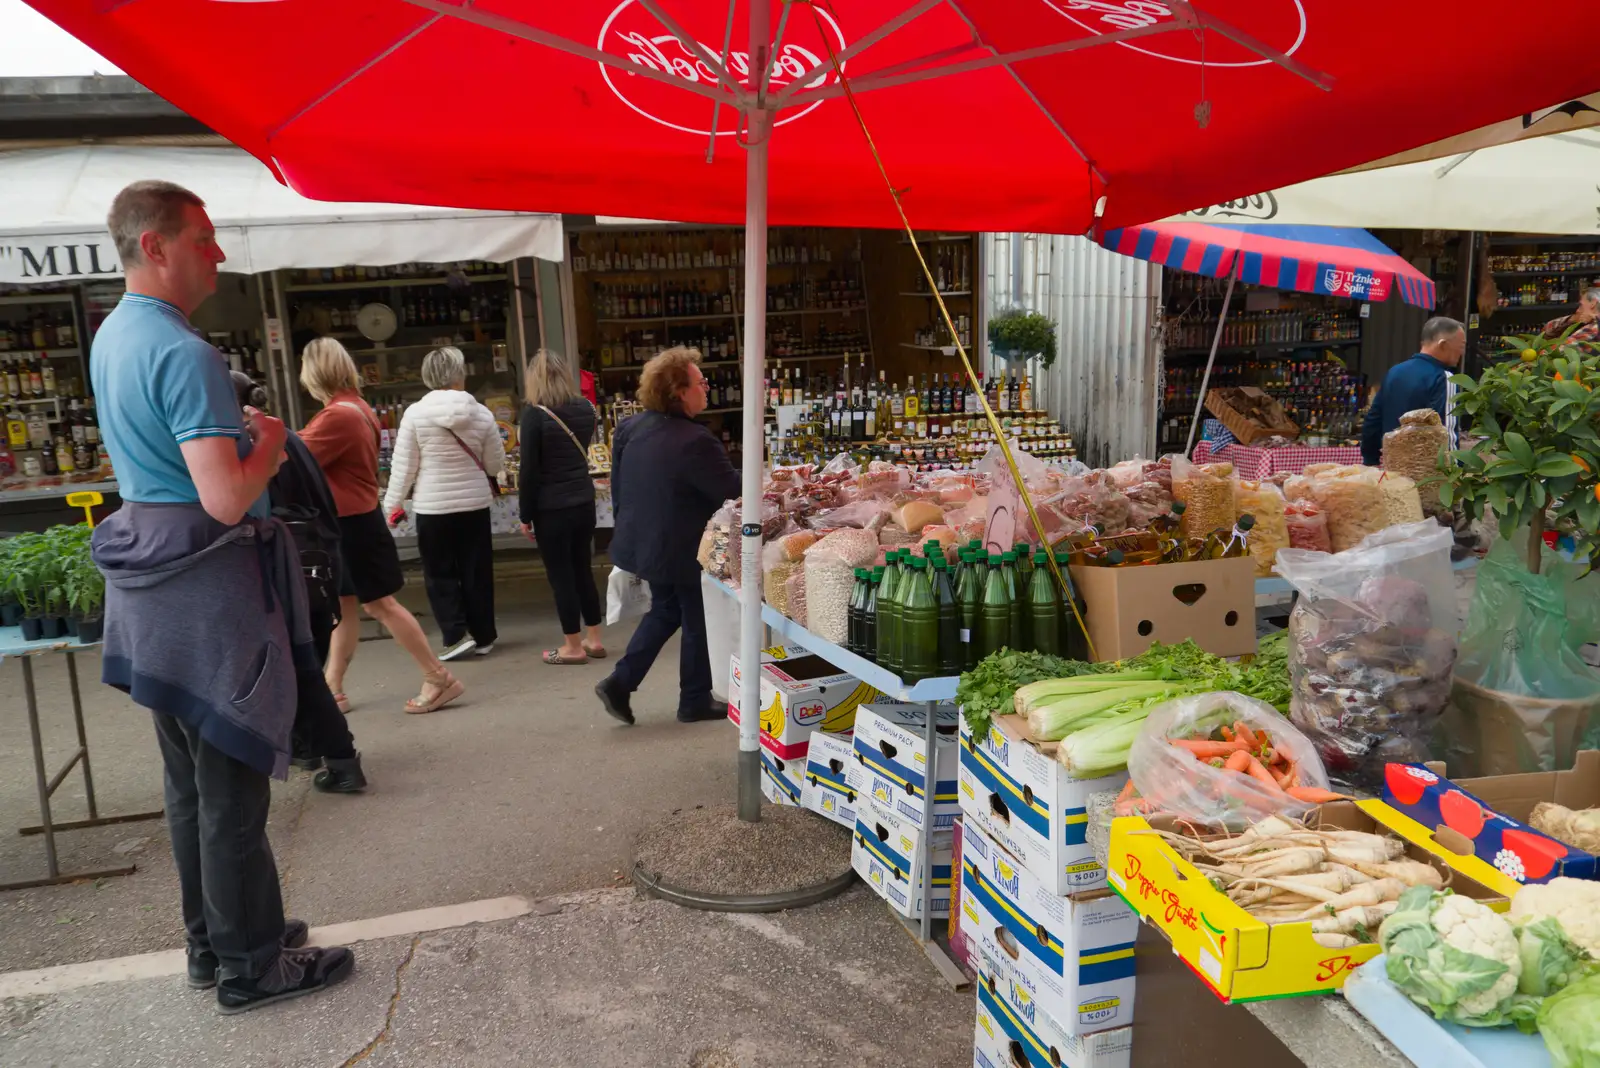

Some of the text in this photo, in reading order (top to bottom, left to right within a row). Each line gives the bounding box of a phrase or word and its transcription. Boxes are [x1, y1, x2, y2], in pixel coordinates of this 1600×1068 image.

[1345, 271, 1381, 286] Tržnice
[1343, 281, 1365, 294] Split
[799, 704, 823, 718] Dole
[874, 720, 914, 748] PREMIUM PACK
[823, 741, 853, 757] PREMIUM PAC
[873, 776, 893, 803] BONITA
[888, 817, 901, 832] PACK
[993, 826, 1027, 860] PREMIUM
[1072, 863, 1101, 871] CUADOR
[992, 856, 1019, 900] BONITA
[1075, 872, 1099, 881] 100%
[1125, 853, 1160, 900] Doppio
[1161, 888, 1198, 931] Gusto
[982, 932, 1037, 994] PREMIUM PACK
[1009, 978, 1035, 1026] BONITA
[1087, 1009, 1111, 1020] 100%
